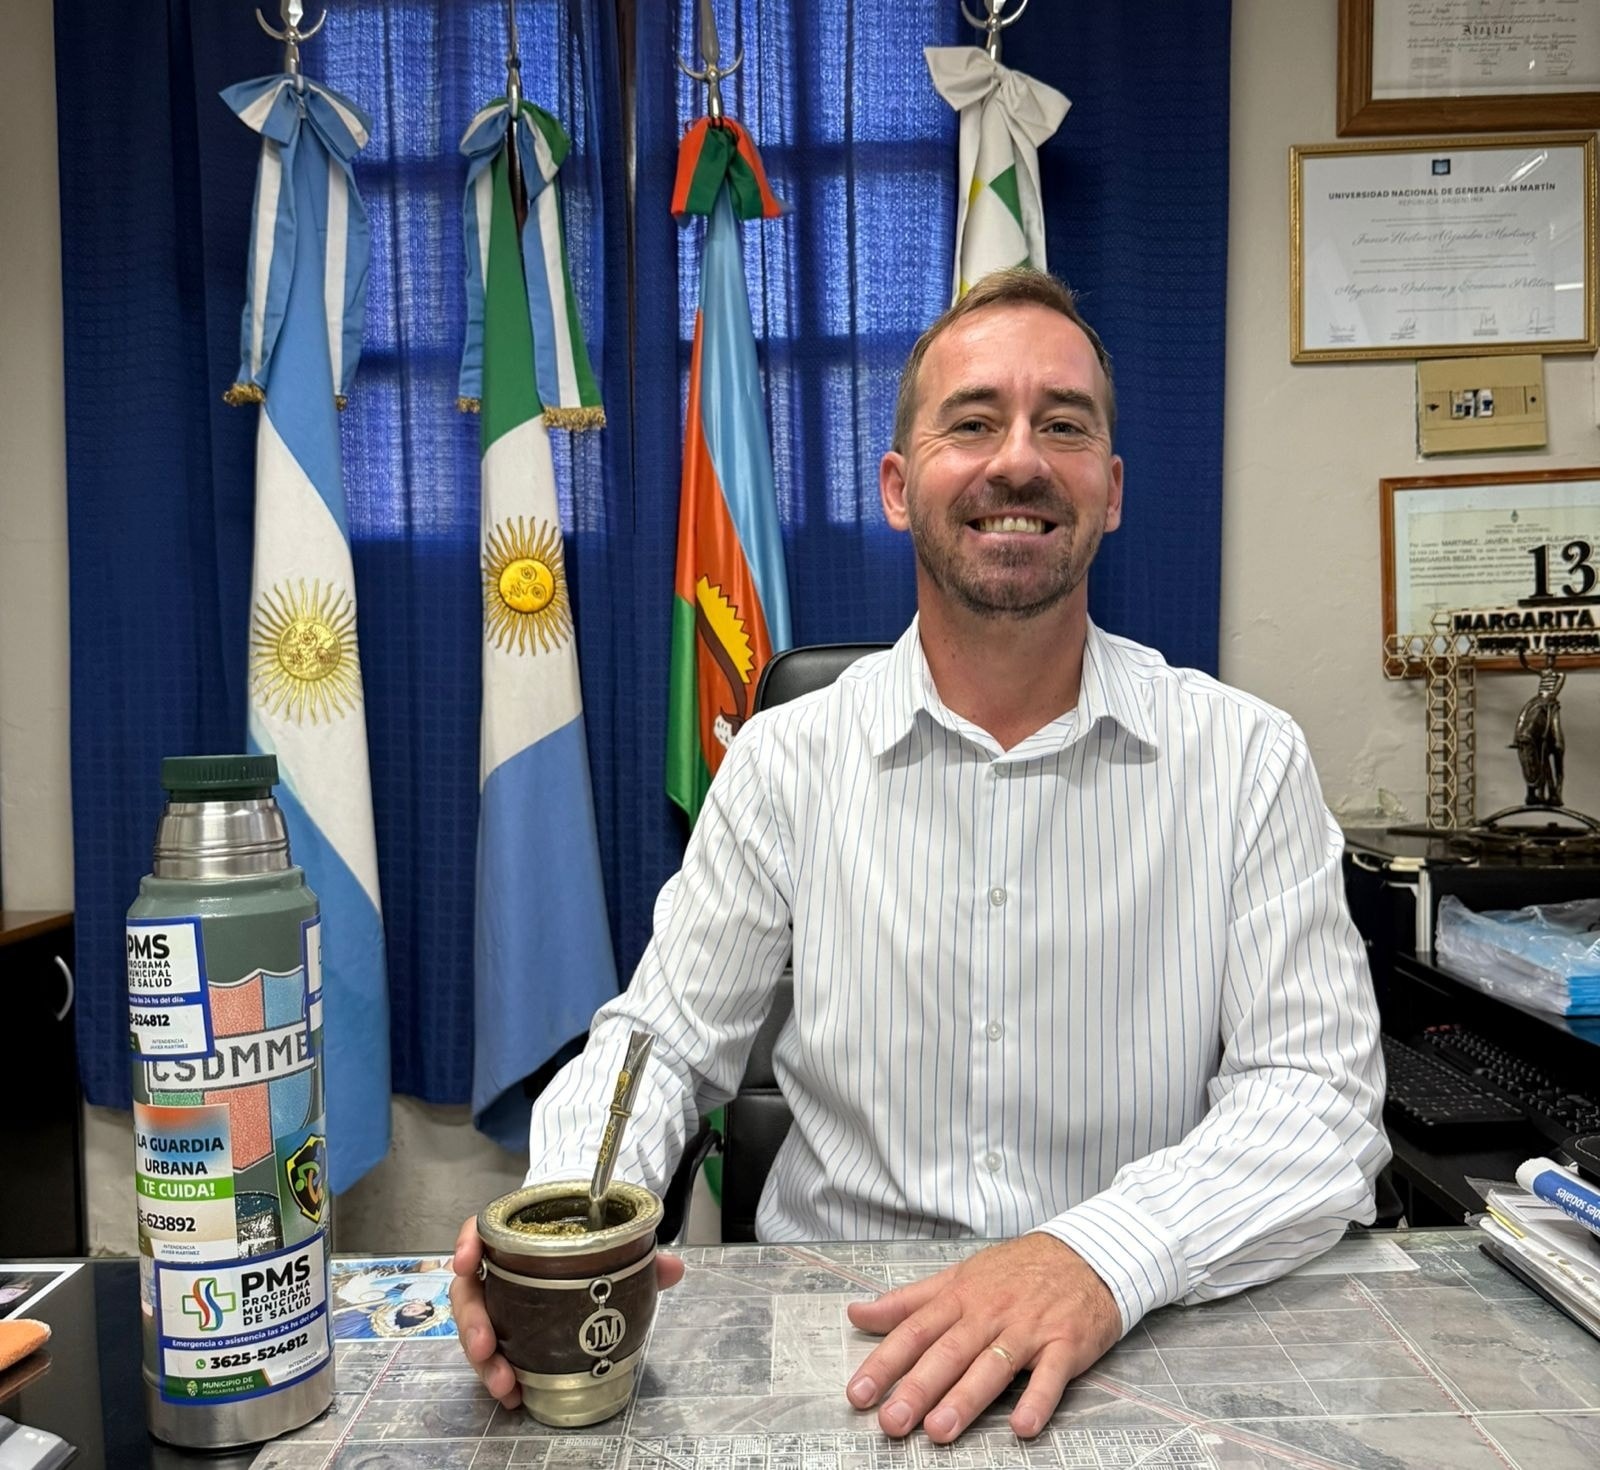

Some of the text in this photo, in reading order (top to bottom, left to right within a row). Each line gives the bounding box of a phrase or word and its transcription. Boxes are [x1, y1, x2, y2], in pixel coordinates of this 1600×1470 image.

[1328, 182, 1556, 200] UNIVERSIDAD NACIONAL DE GENERAL SAN MARTÍN
[1528, 541, 1596, 598] 13
[1454, 609, 1595, 629] MARGARITA
[128, 933, 170, 960] PMS
[128, 968, 172, 978] UNICIPAL
[138, 978, 173, 988] SALUD
[137, 1133, 225, 1153] LA GUARDIA
[145, 1158, 208, 1175] URBANA
[143, 1178, 216, 1198] TE CUIDA!
[1555, 1187, 1588, 1211] sociales
[241, 1254, 311, 1298] PMS
[242, 1279, 311, 1308] PROGRAMA
[242, 1288, 311, 1317] MUNICIPAL
[243, 1296, 311, 1327] DE SALUD
[172, 1339, 216, 1349] Emergencia
[224, 1331, 266, 1345] asistencia
[290, 1321, 299, 1329] hs
[586, 1315, 621, 1351] JM
[210, 1332, 308, 1370] 3625-524812
[202, 1375, 253, 1389] MUNICIPIO DE
[202, 1387, 235, 1395] MARGARITA
